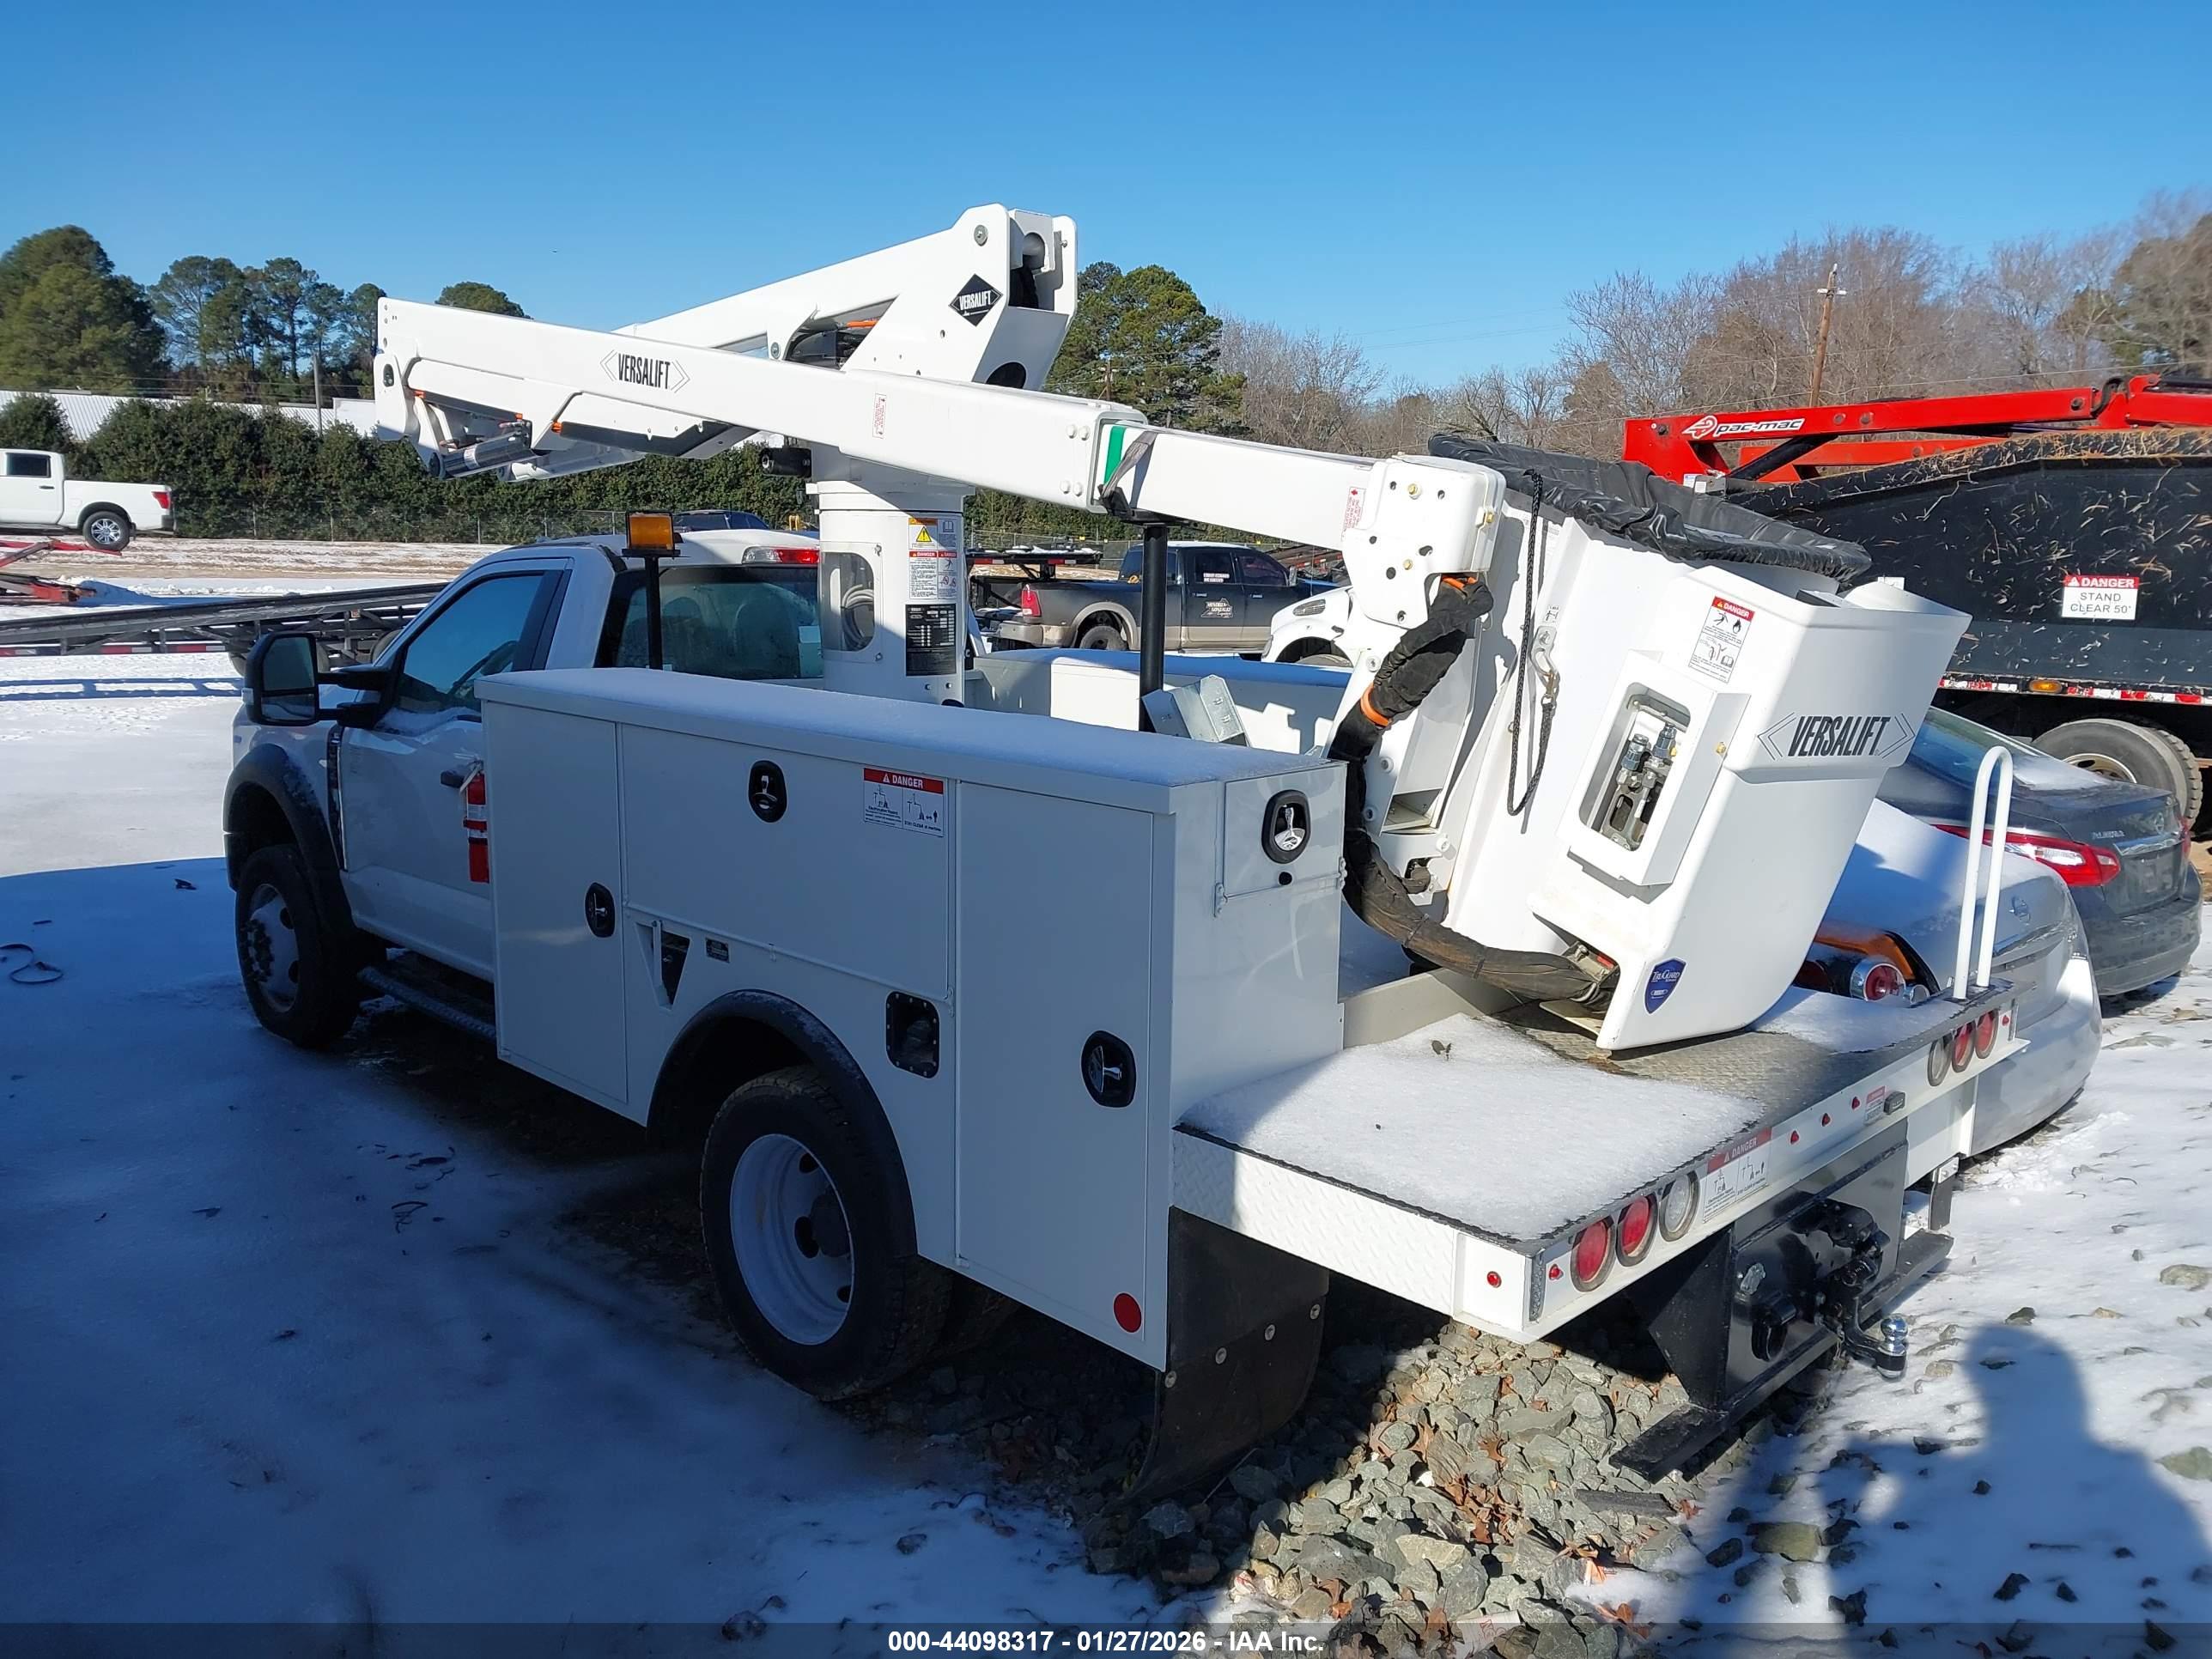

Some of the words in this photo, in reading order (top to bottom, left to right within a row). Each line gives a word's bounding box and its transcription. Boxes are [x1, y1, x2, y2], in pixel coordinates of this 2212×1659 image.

[958, 290, 992, 311] VERSALIFT
[618, 353, 671, 390] VERSALIFT
[1715, 419, 1804, 436] pac-mac
[2081, 577, 2135, 587] DANGER
[2080, 592, 2121, 602] STAND
[1723, 602, 1750, 618] DANGER
[2070, 604, 2111, 613] CLEAR
[1788, 716, 1891, 757] VERSALIFT
[892, 775, 924, 789] DANGER
[1732, 1137, 1758, 1157] DANGER
